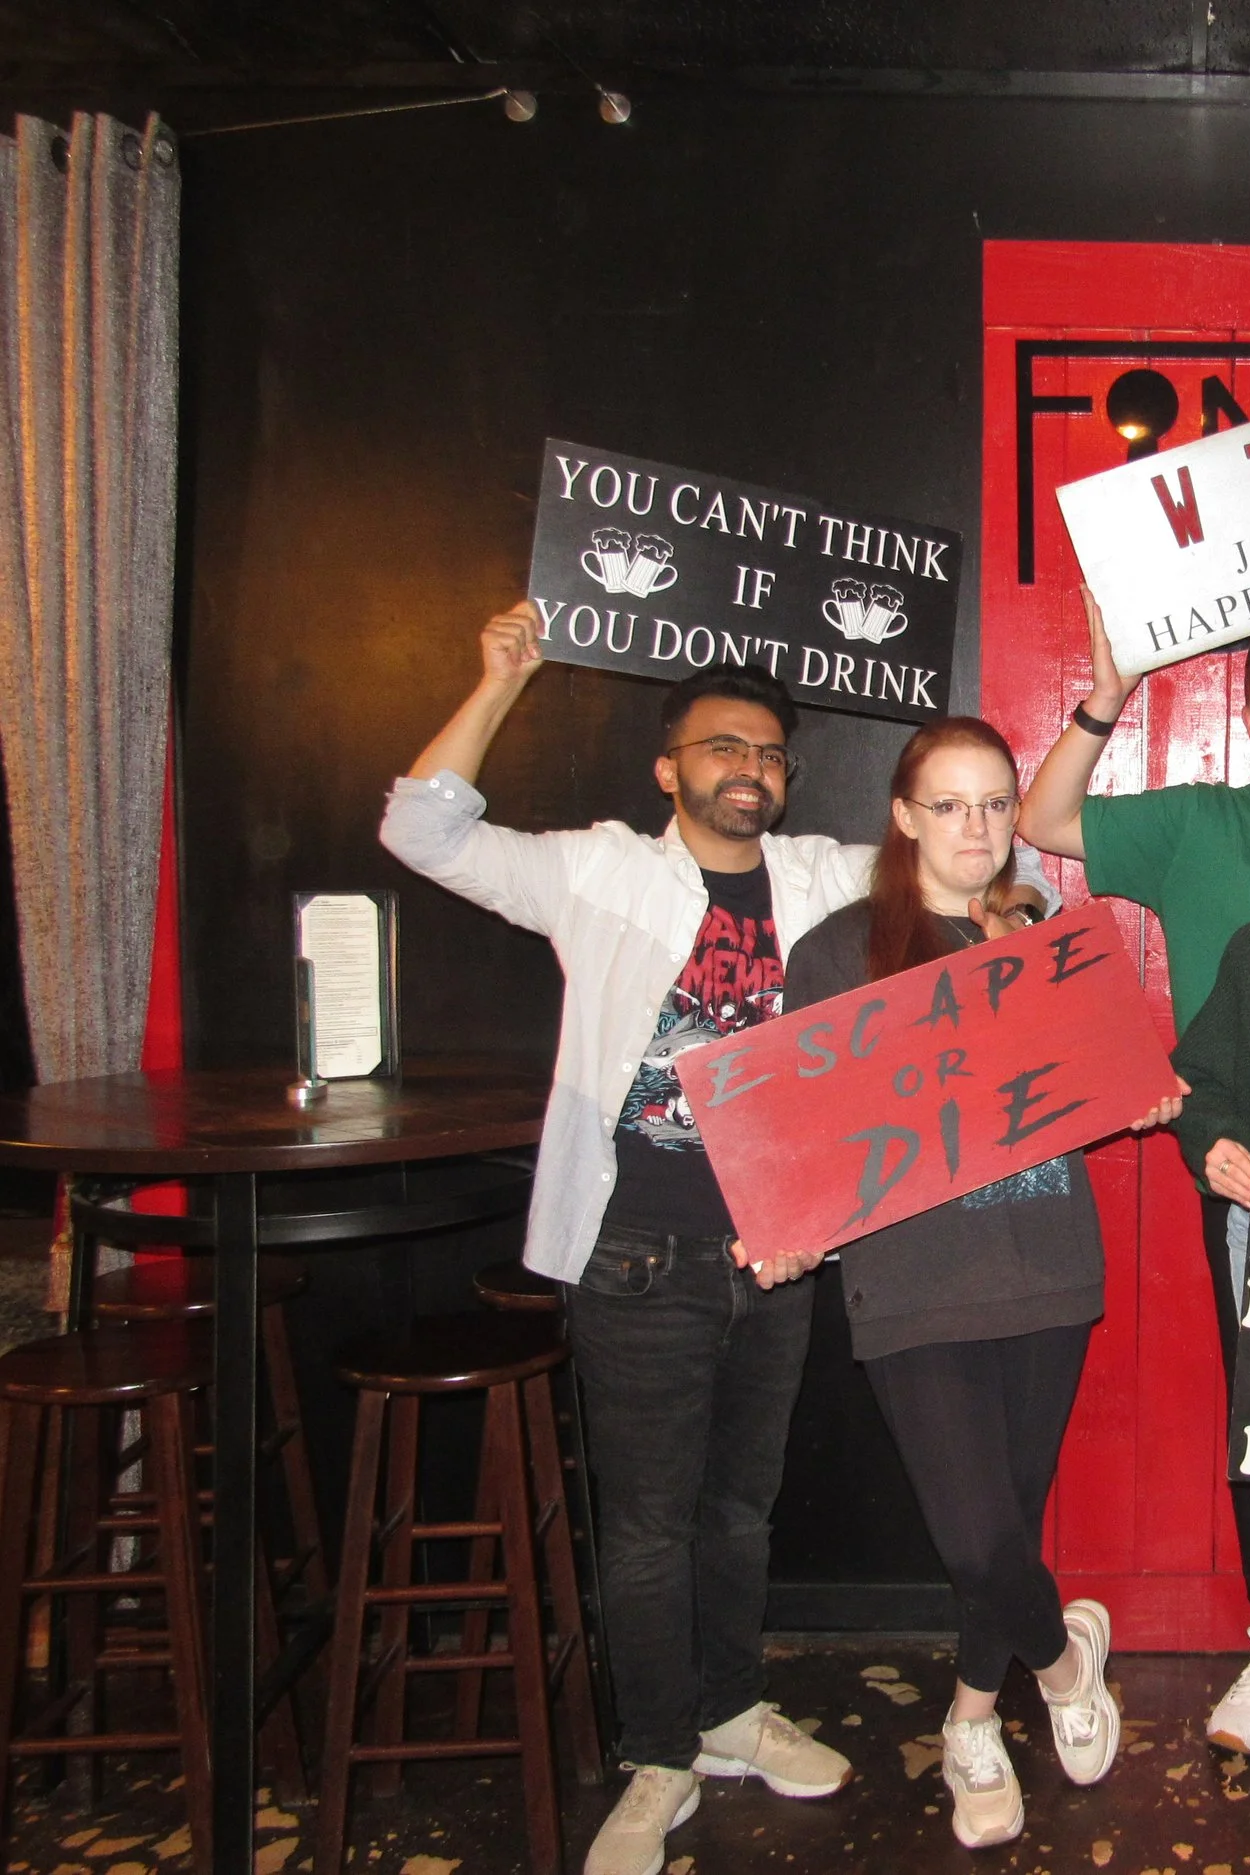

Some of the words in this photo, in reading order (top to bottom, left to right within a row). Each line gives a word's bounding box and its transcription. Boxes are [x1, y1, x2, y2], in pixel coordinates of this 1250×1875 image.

[557, 456, 658, 515] YOU
[671, 484, 806, 548] CAN'T
[818, 516, 949, 582] THINK
[733, 565, 776, 609] IF
[534, 598, 639, 653] YOU
[650, 619, 788, 679] DON'T
[799, 647, 938, 709] DRINK
[706, 928, 1113, 1107] ESCAPE
[893, 1049, 973, 1097] OR
[824, 1062, 1099, 1242] DIE
